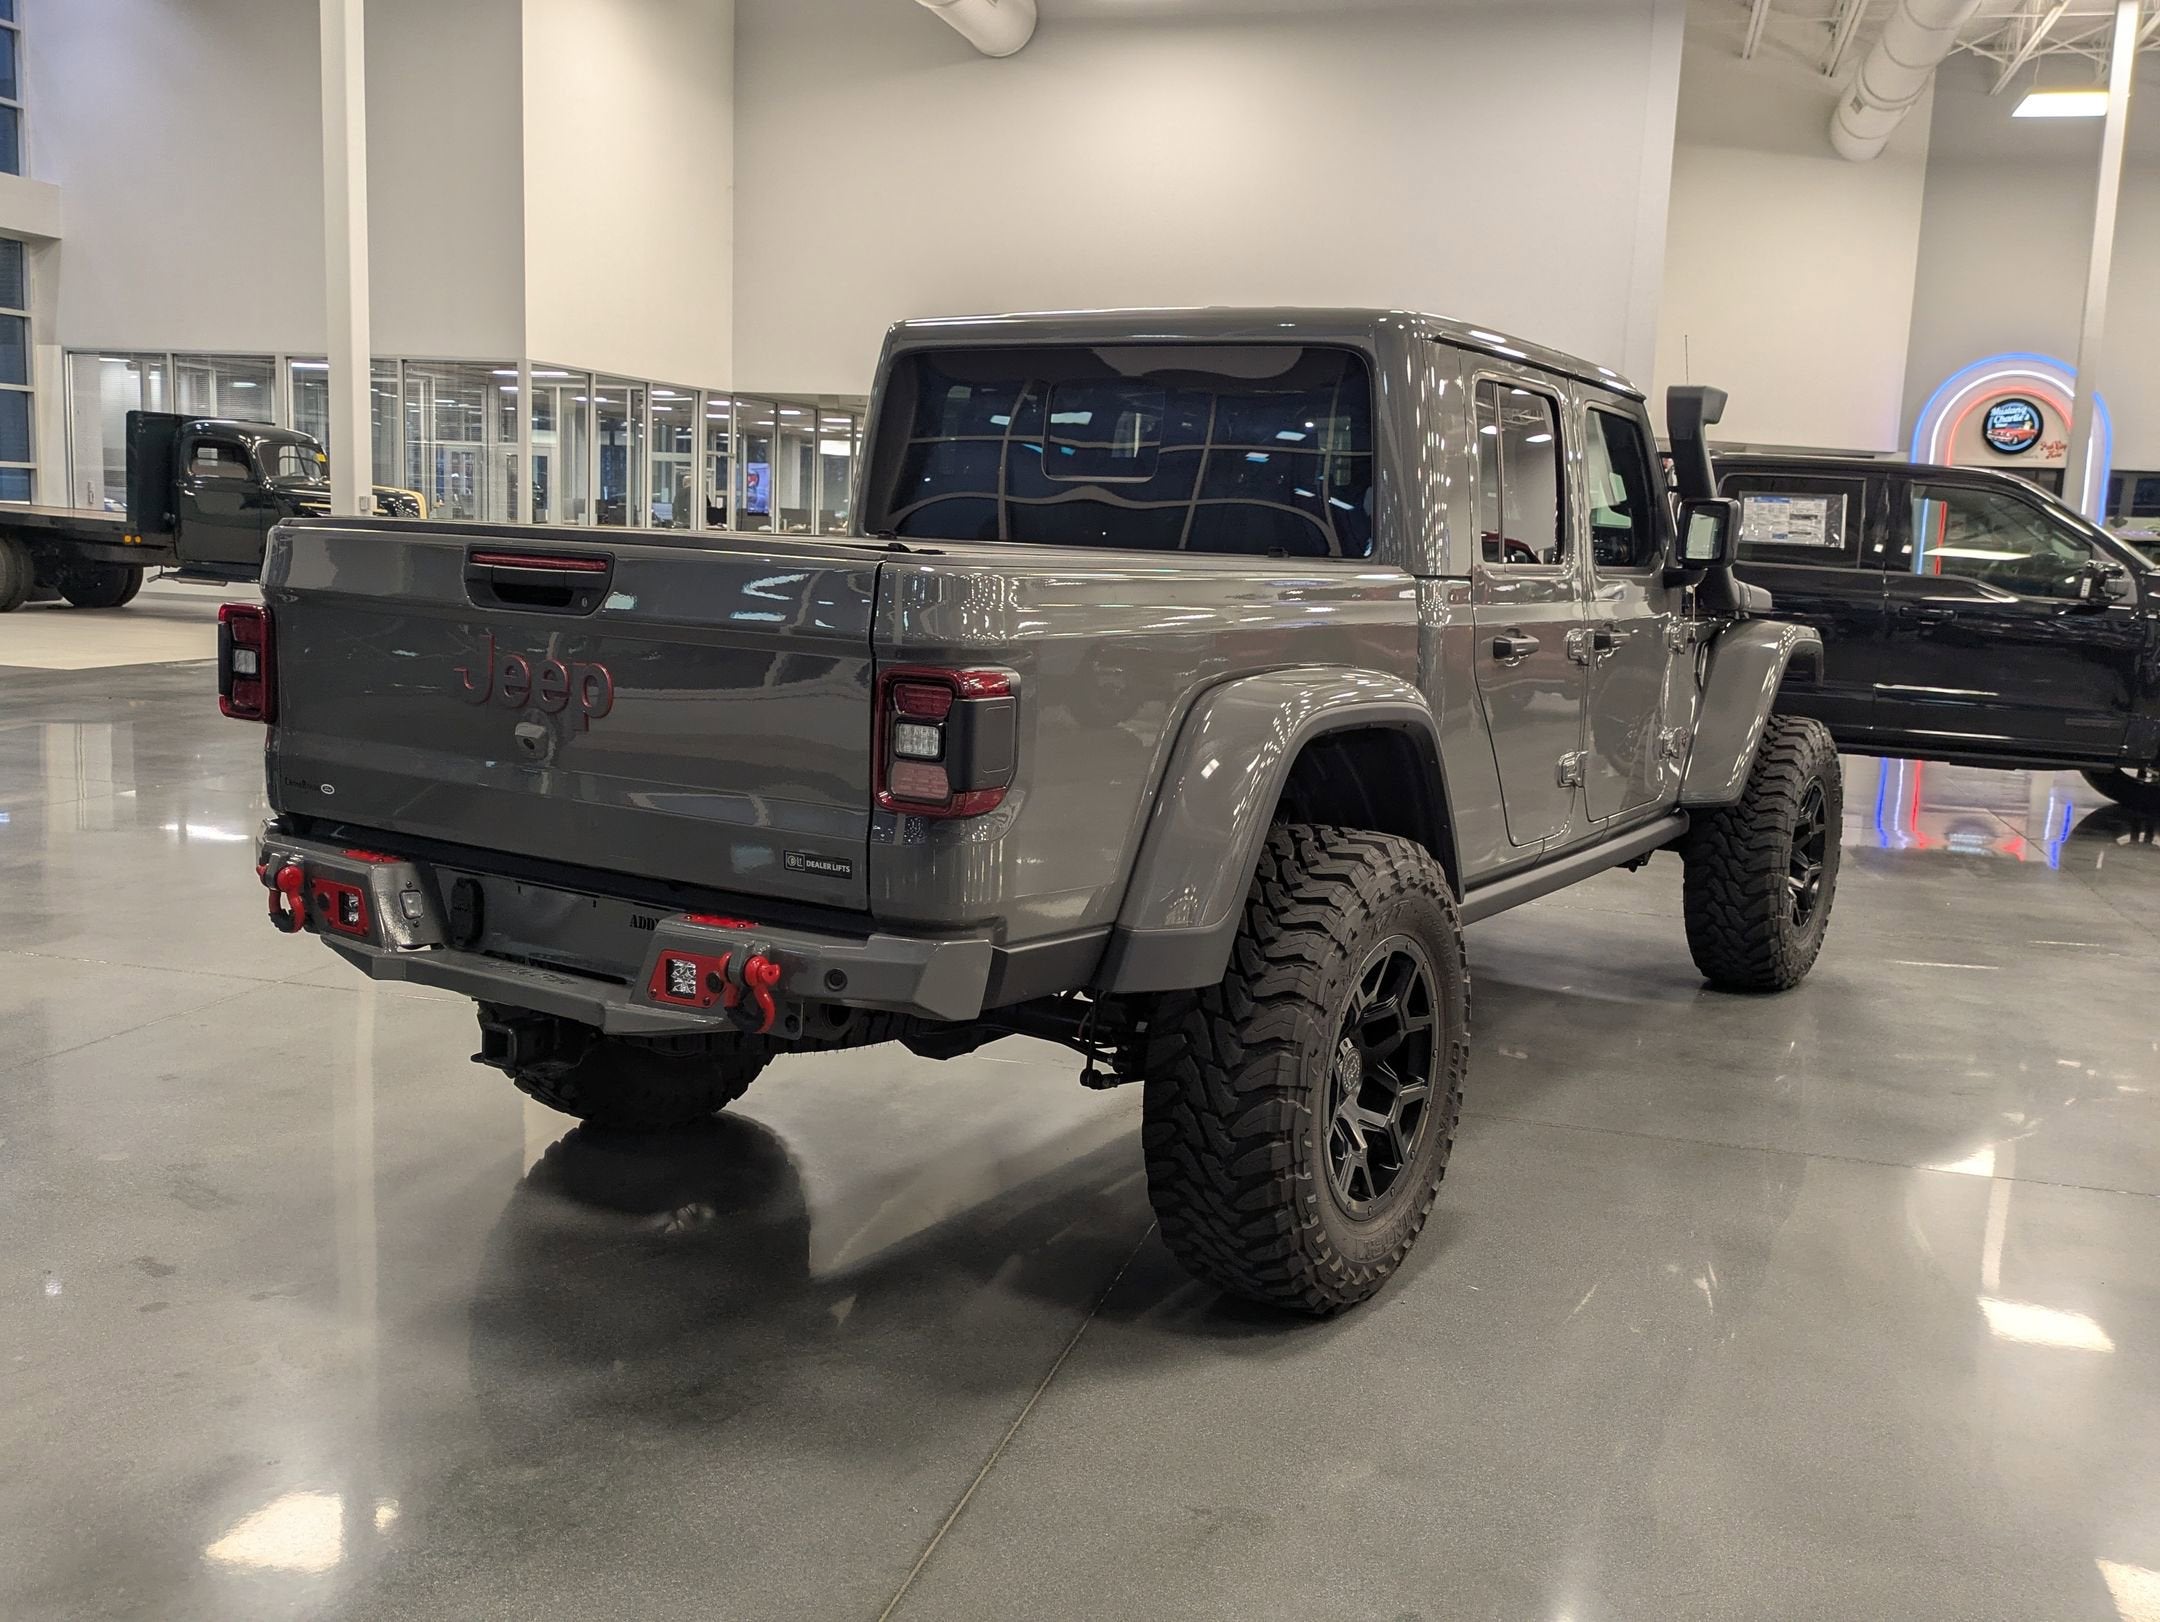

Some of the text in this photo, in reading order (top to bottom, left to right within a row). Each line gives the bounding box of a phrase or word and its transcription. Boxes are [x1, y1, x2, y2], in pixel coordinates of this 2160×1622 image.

[453, 633, 614, 733] Jeep
[806, 859, 851, 873] DEALER LIFTS
[629, 913, 660, 931] ADD
